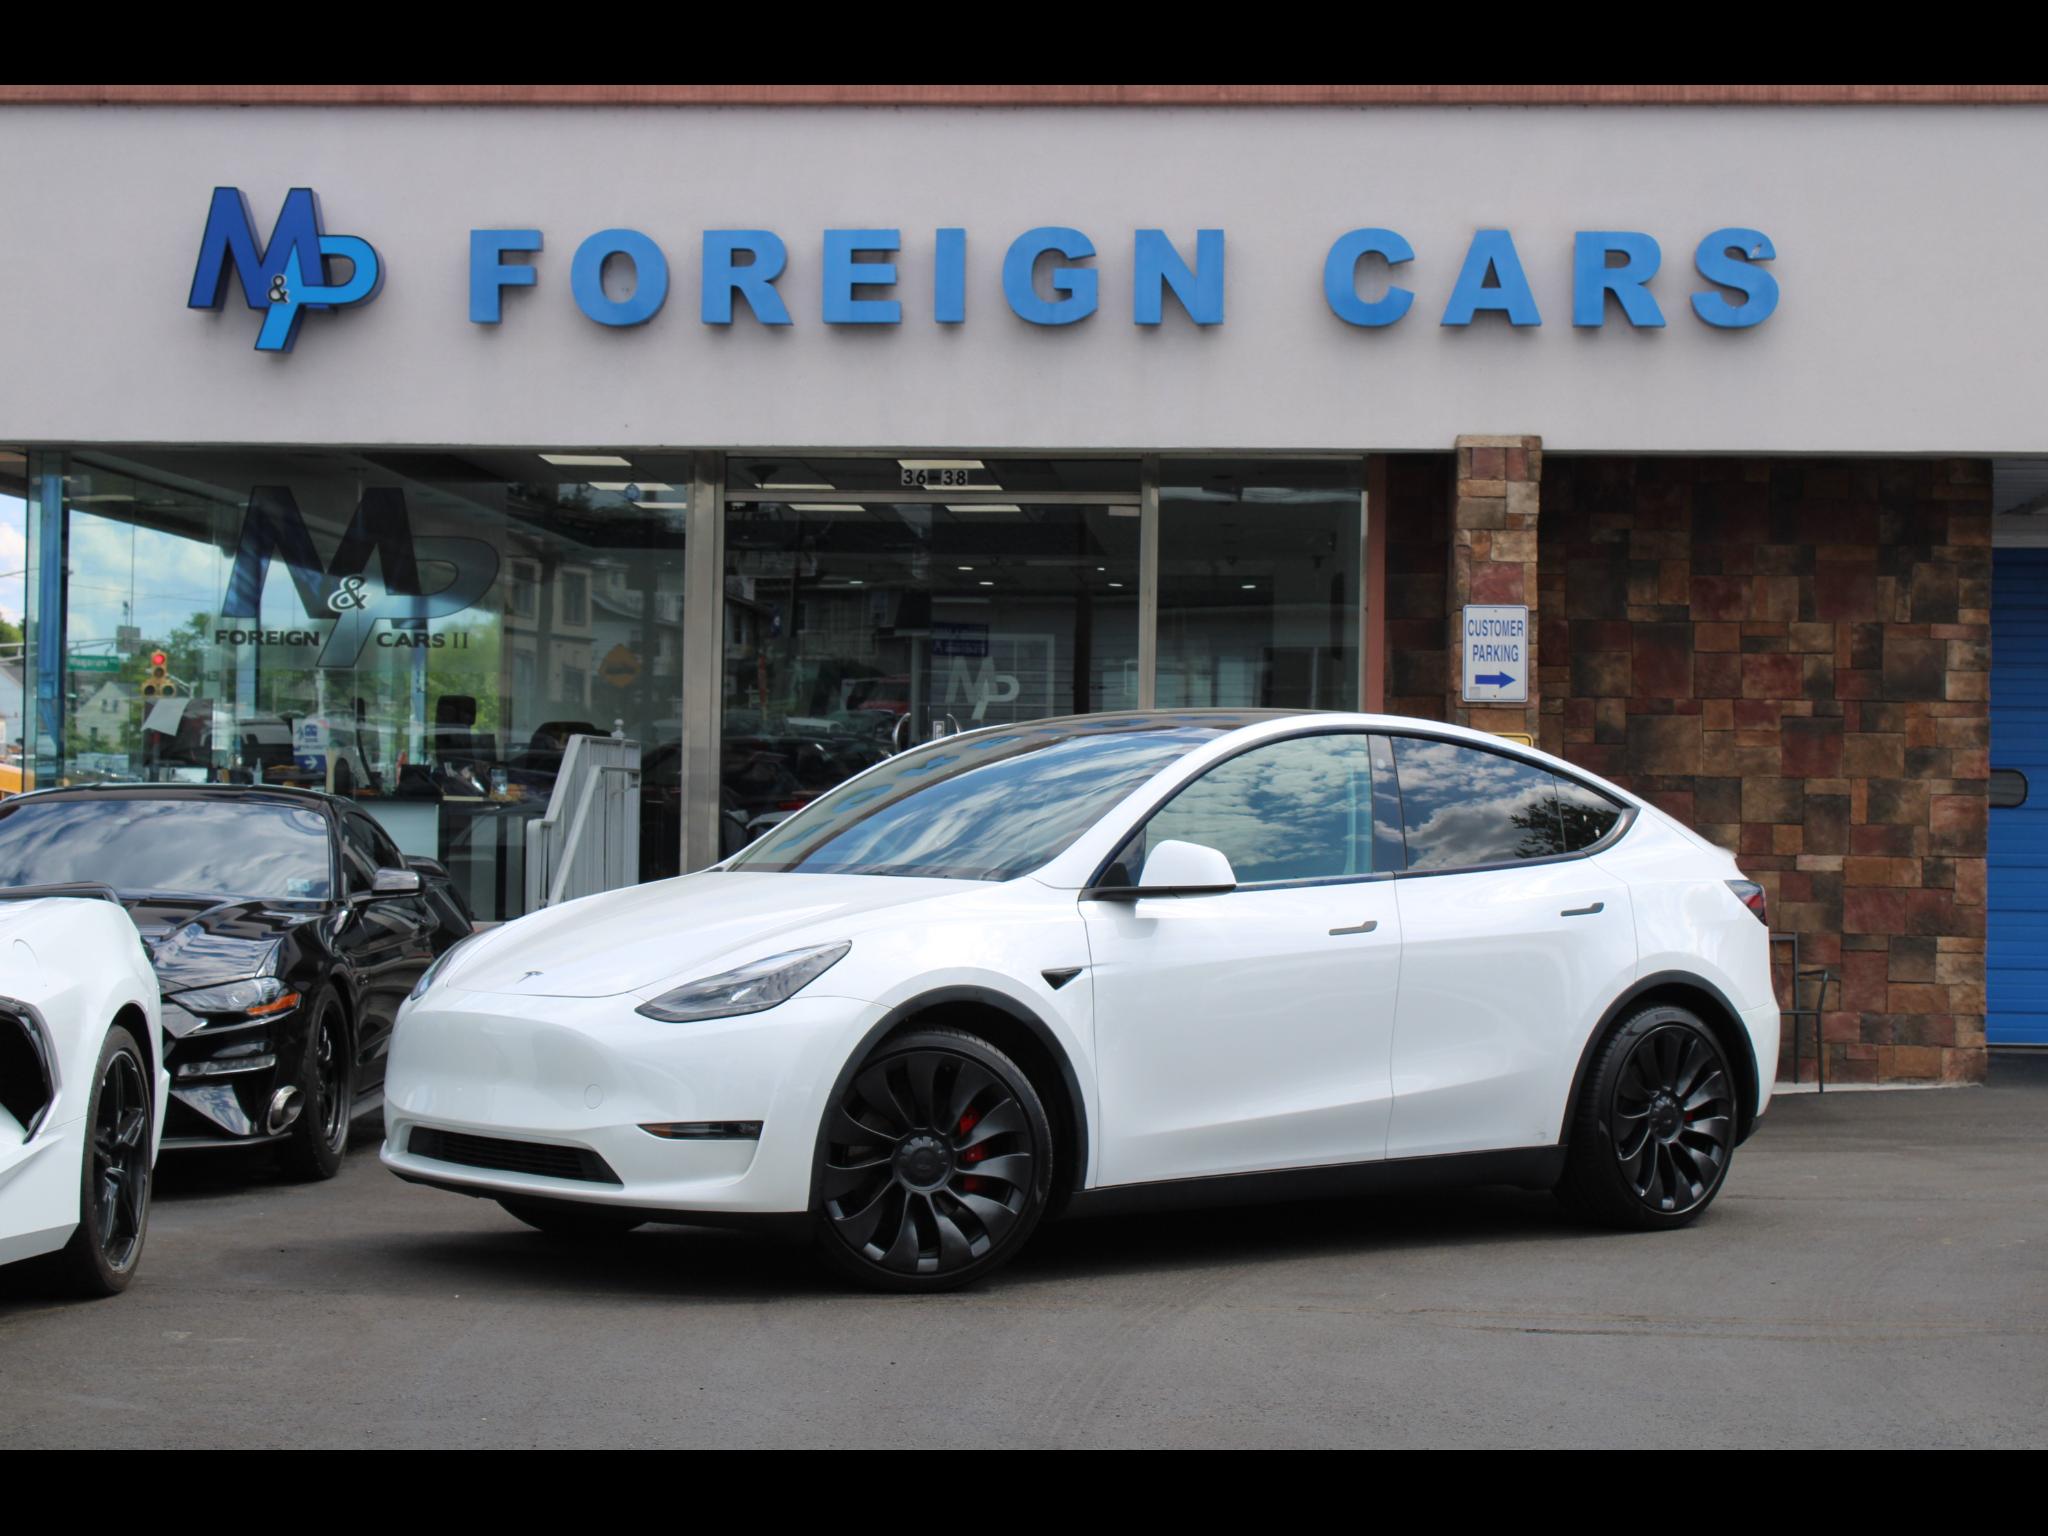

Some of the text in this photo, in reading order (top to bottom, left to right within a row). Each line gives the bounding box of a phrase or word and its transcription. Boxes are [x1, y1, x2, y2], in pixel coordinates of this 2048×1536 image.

[469, 228, 1225, 327] FOREIGN
[1323, 227, 1780, 329] CARS
[1468, 619, 1524, 637] CUSTOMER
[215, 630, 320, 646] FOREIGN
[376, 632, 446, 649] CARS
[1472, 644, 1519, 662] PARKING
